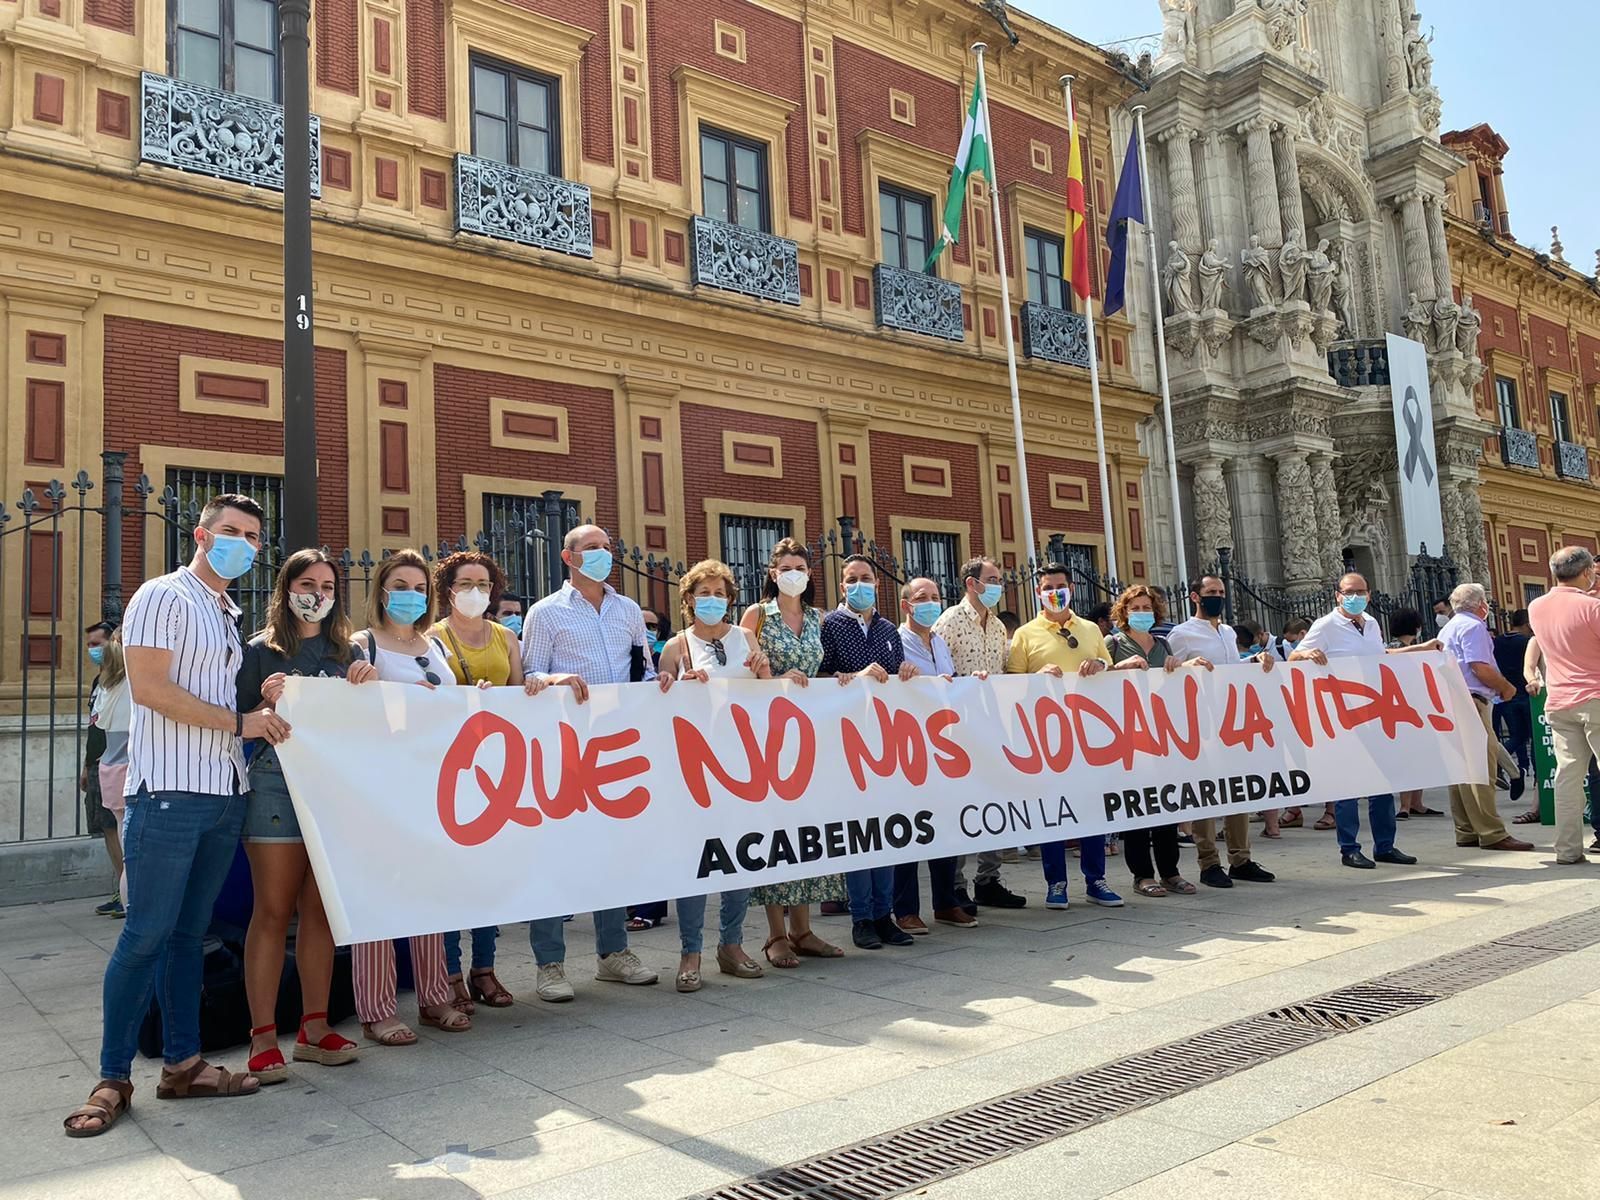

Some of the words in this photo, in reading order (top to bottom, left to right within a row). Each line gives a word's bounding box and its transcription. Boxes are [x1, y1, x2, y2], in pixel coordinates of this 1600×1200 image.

[436, 710, 652, 847] QUE
[672, 696, 817, 809] NO
[841, 697, 972, 792] NOS
[1001, 674, 1201, 775] JODAN
[1218, 682, 1275, 753] LA
[1280, 662, 1455, 749] VIDA!
[696, 810, 936, 879] ACABEMOS
[959, 799, 1032, 839] CON
[1038, 795, 1079, 828] LA
[1104, 769, 1311, 822] PRECARIEDAD
